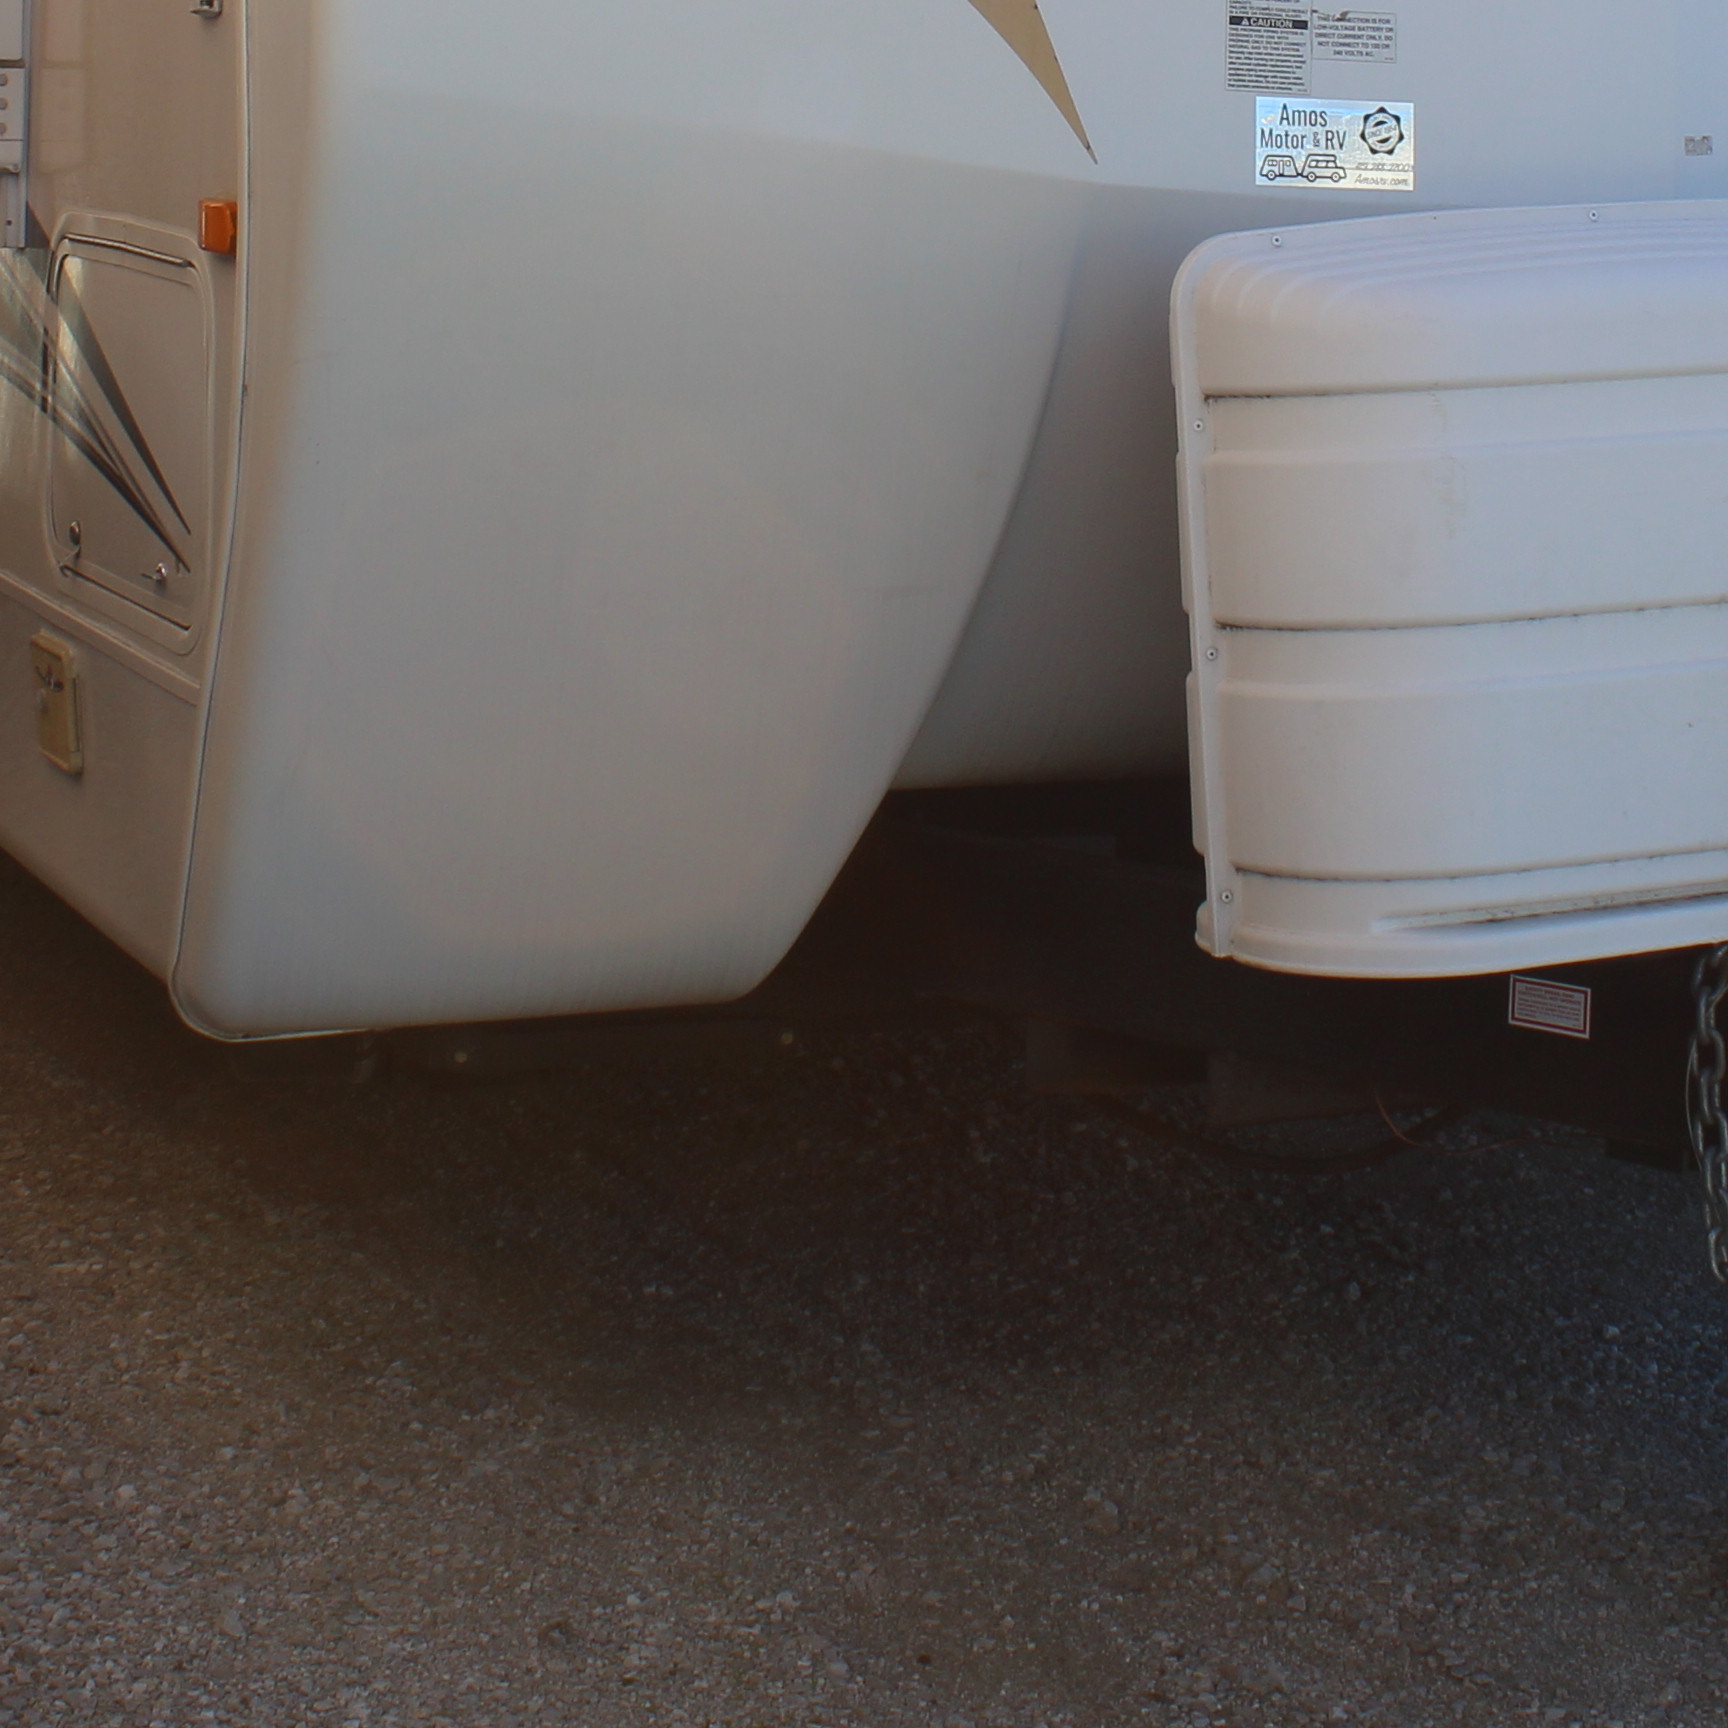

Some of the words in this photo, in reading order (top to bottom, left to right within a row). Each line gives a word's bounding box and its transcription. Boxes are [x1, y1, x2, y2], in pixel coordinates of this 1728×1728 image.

[1250, 17, 1293, 28] CAUTION
[1279, 103, 1328, 127] Amos
[1260, 127, 1307, 149] Motor
[1312, 131, 1320, 147] &
[1325, 129, 1347, 150] RV
